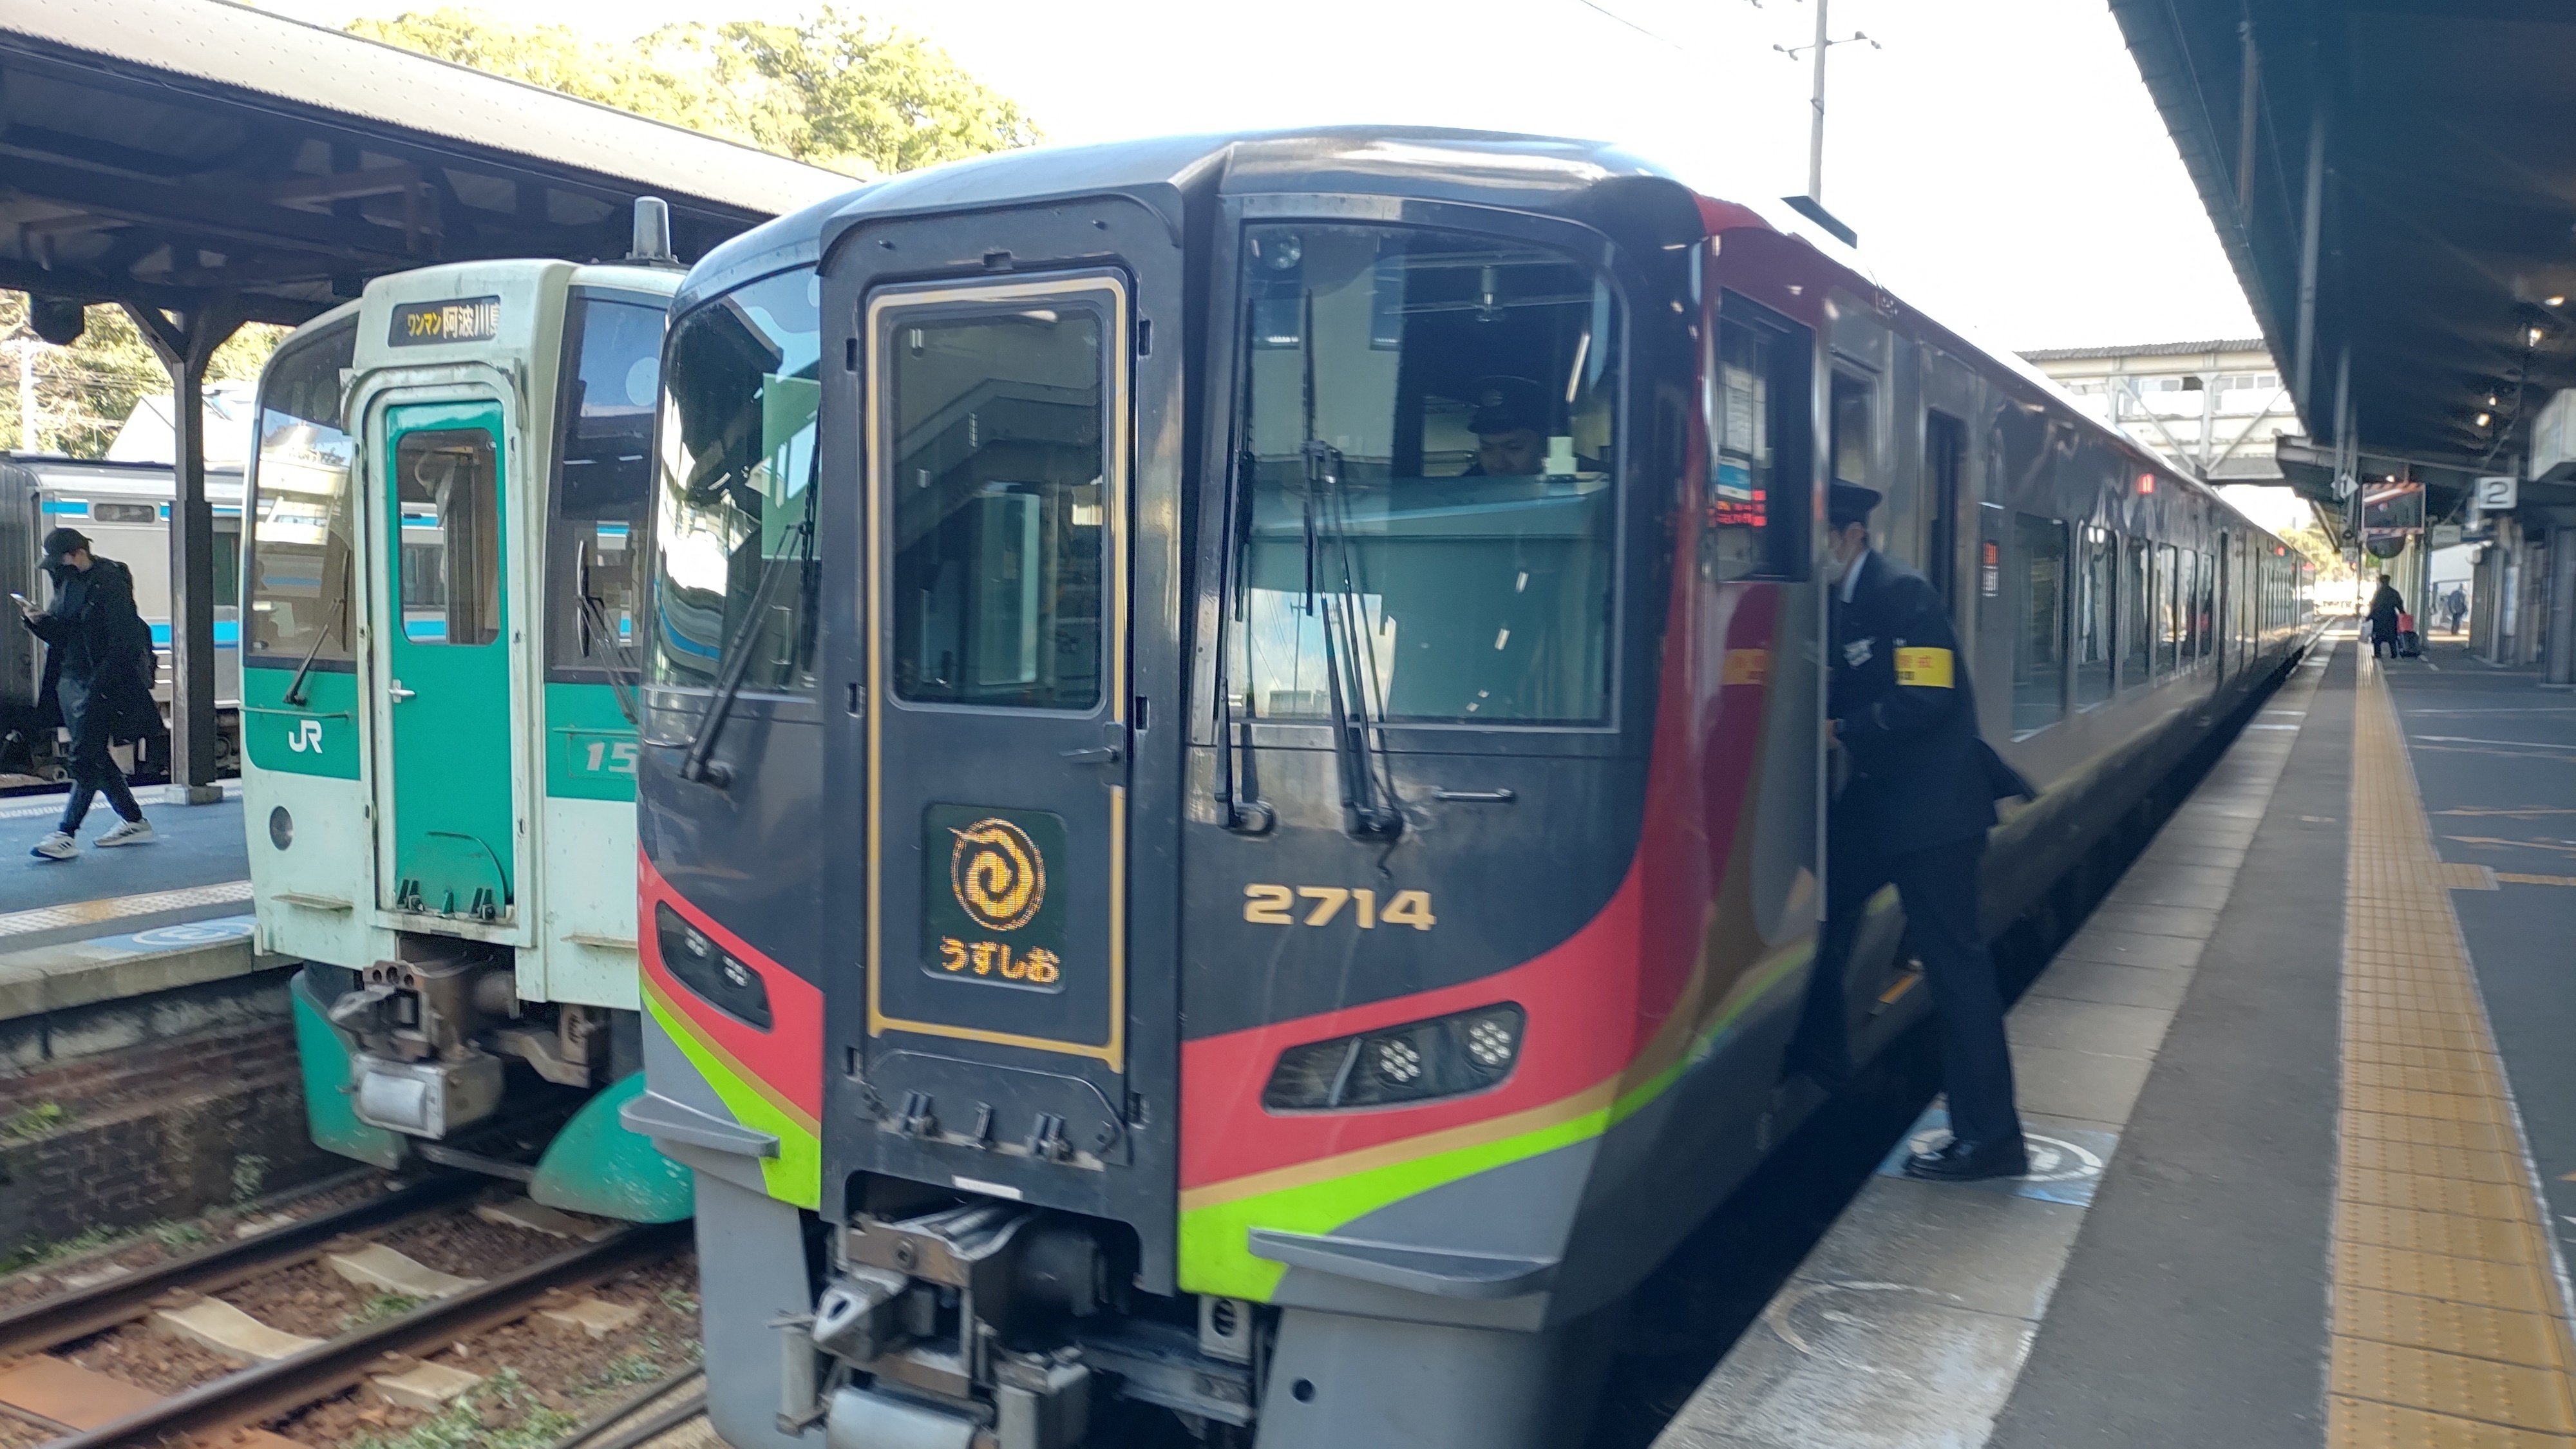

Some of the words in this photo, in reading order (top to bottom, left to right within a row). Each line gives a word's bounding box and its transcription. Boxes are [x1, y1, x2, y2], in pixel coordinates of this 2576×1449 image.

[407, 312, 442, 337] ワンマン
[2486, 481, 2509, 504] 2
[289, 719, 323, 753] JR
[586, 742, 638, 773] 15
[1243, 883, 1437, 931] 2714
